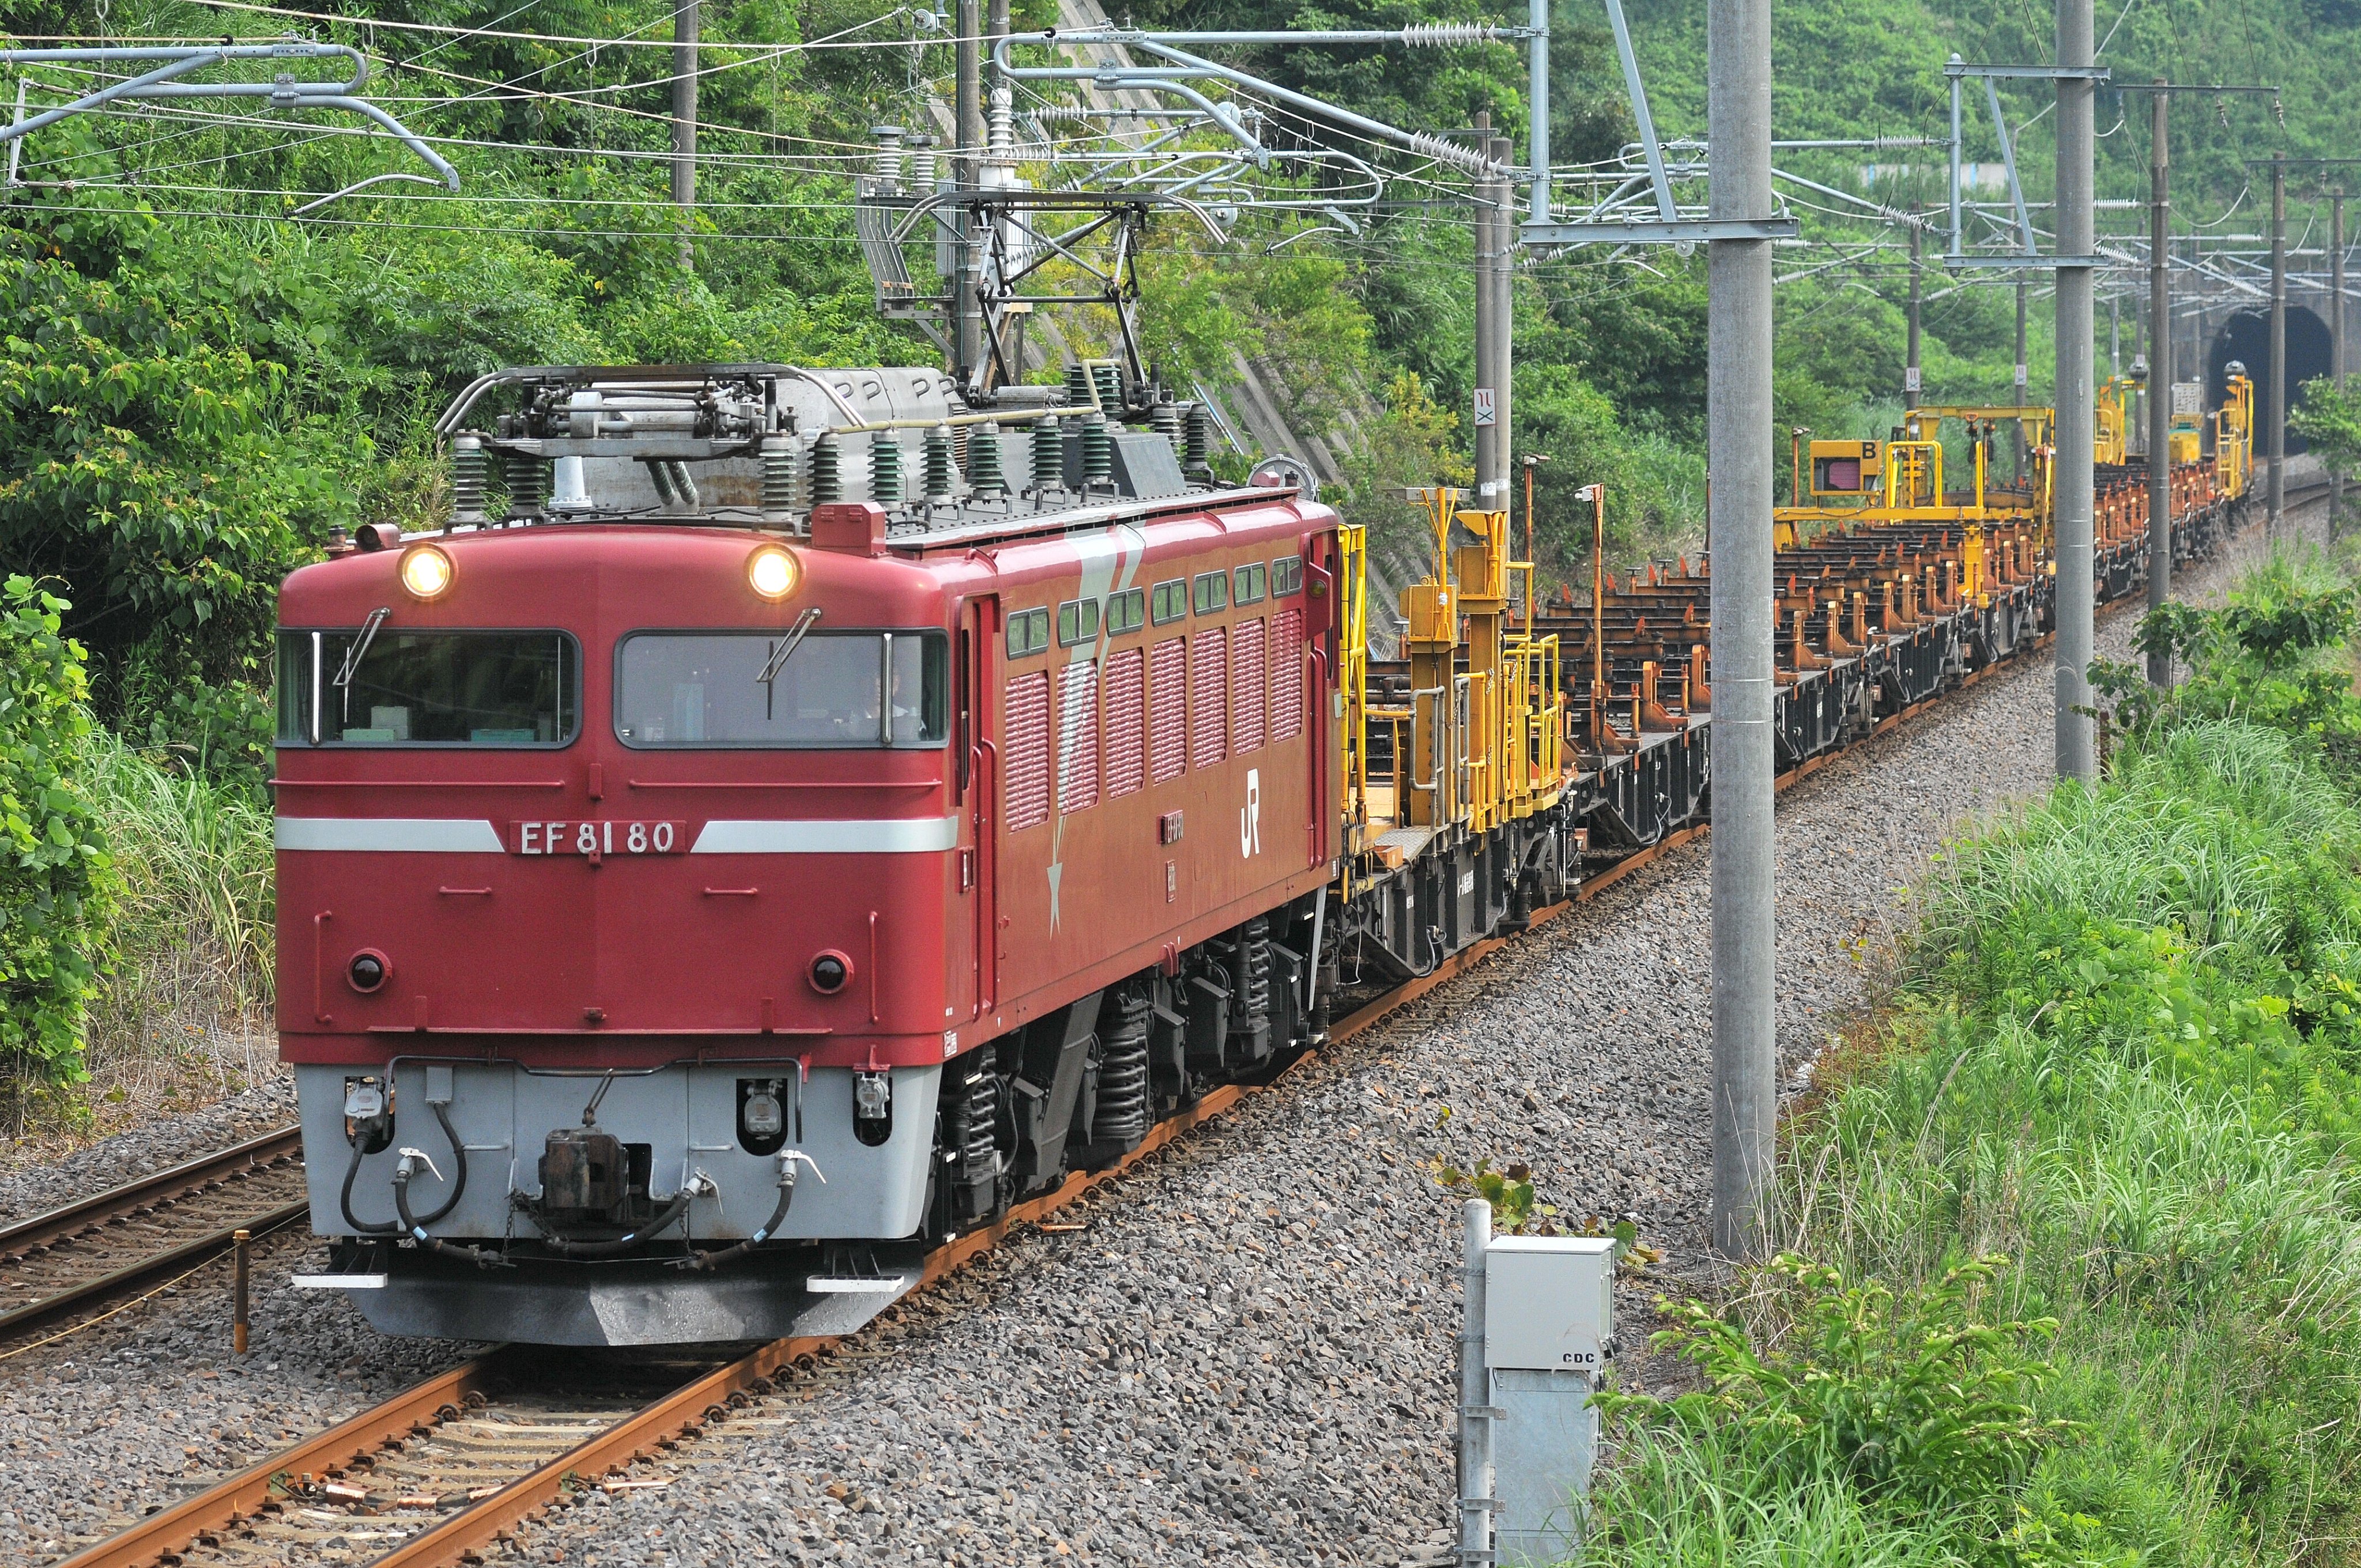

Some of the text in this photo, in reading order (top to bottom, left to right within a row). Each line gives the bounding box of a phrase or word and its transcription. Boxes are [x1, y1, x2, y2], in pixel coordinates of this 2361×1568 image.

[1862, 442, 1876, 459] B
[1241, 768, 1259, 859] JR
[1563, 1353, 1594, 1363] CDC
